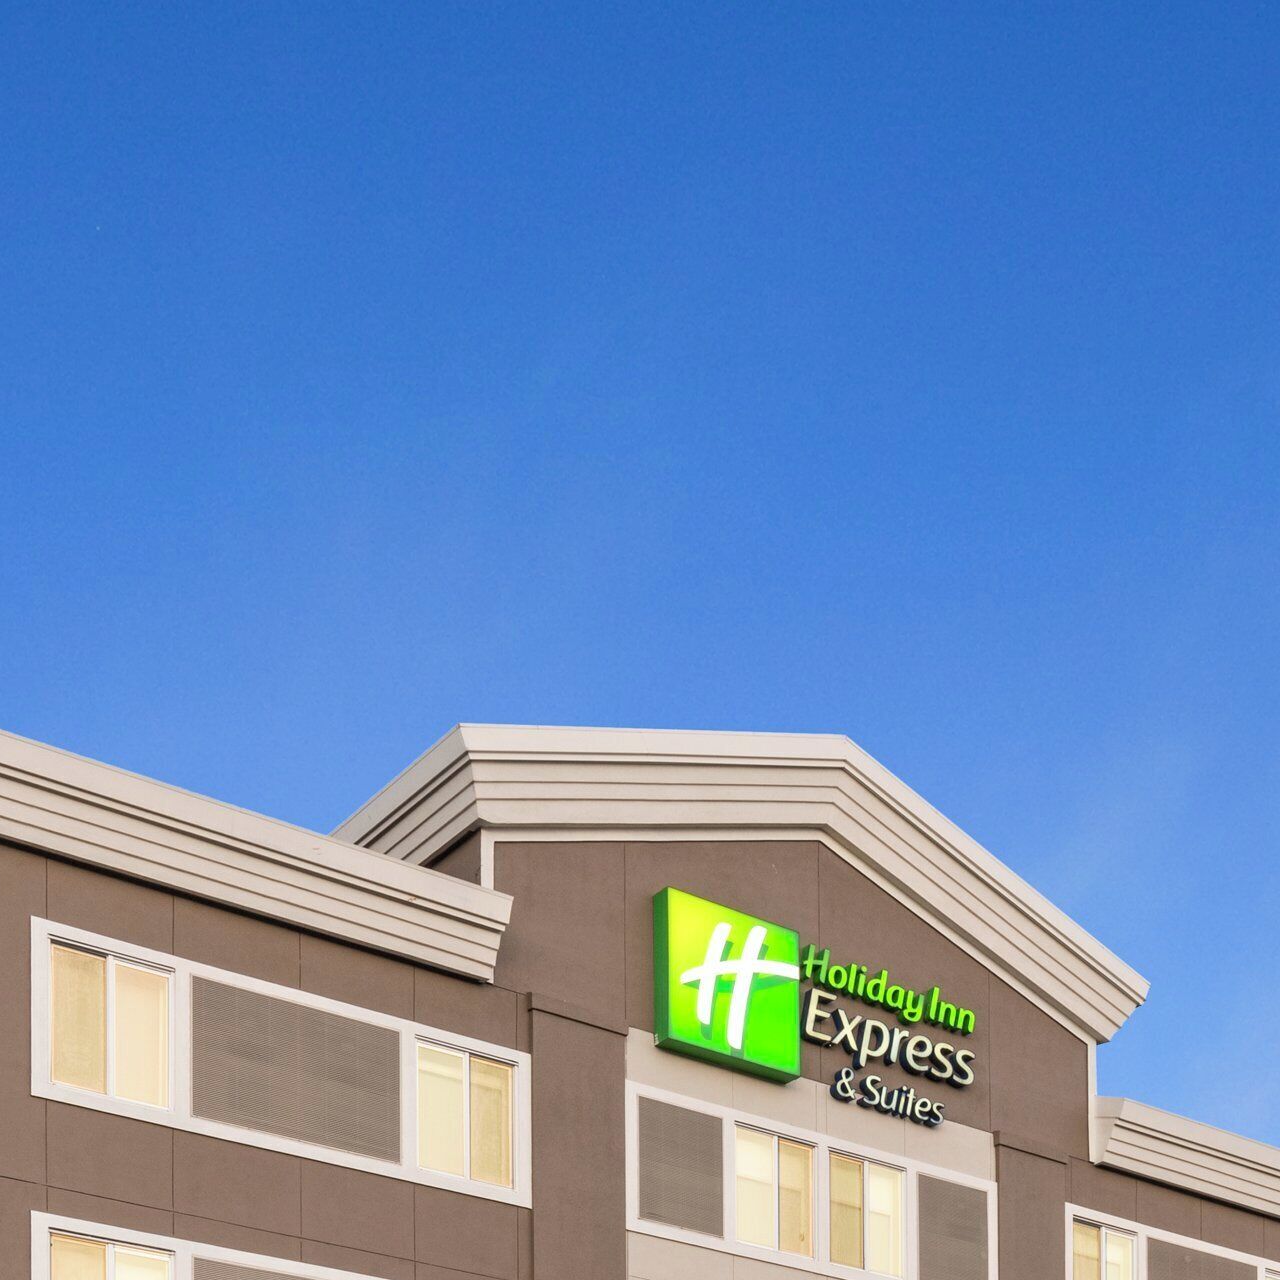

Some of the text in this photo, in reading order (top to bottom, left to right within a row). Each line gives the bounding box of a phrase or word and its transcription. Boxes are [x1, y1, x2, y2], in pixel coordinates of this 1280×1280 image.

[801, 944, 977, 1036] Holiday Inn
[802, 987, 977, 1089] Express
[832, 1066, 945, 1128] & Suites
